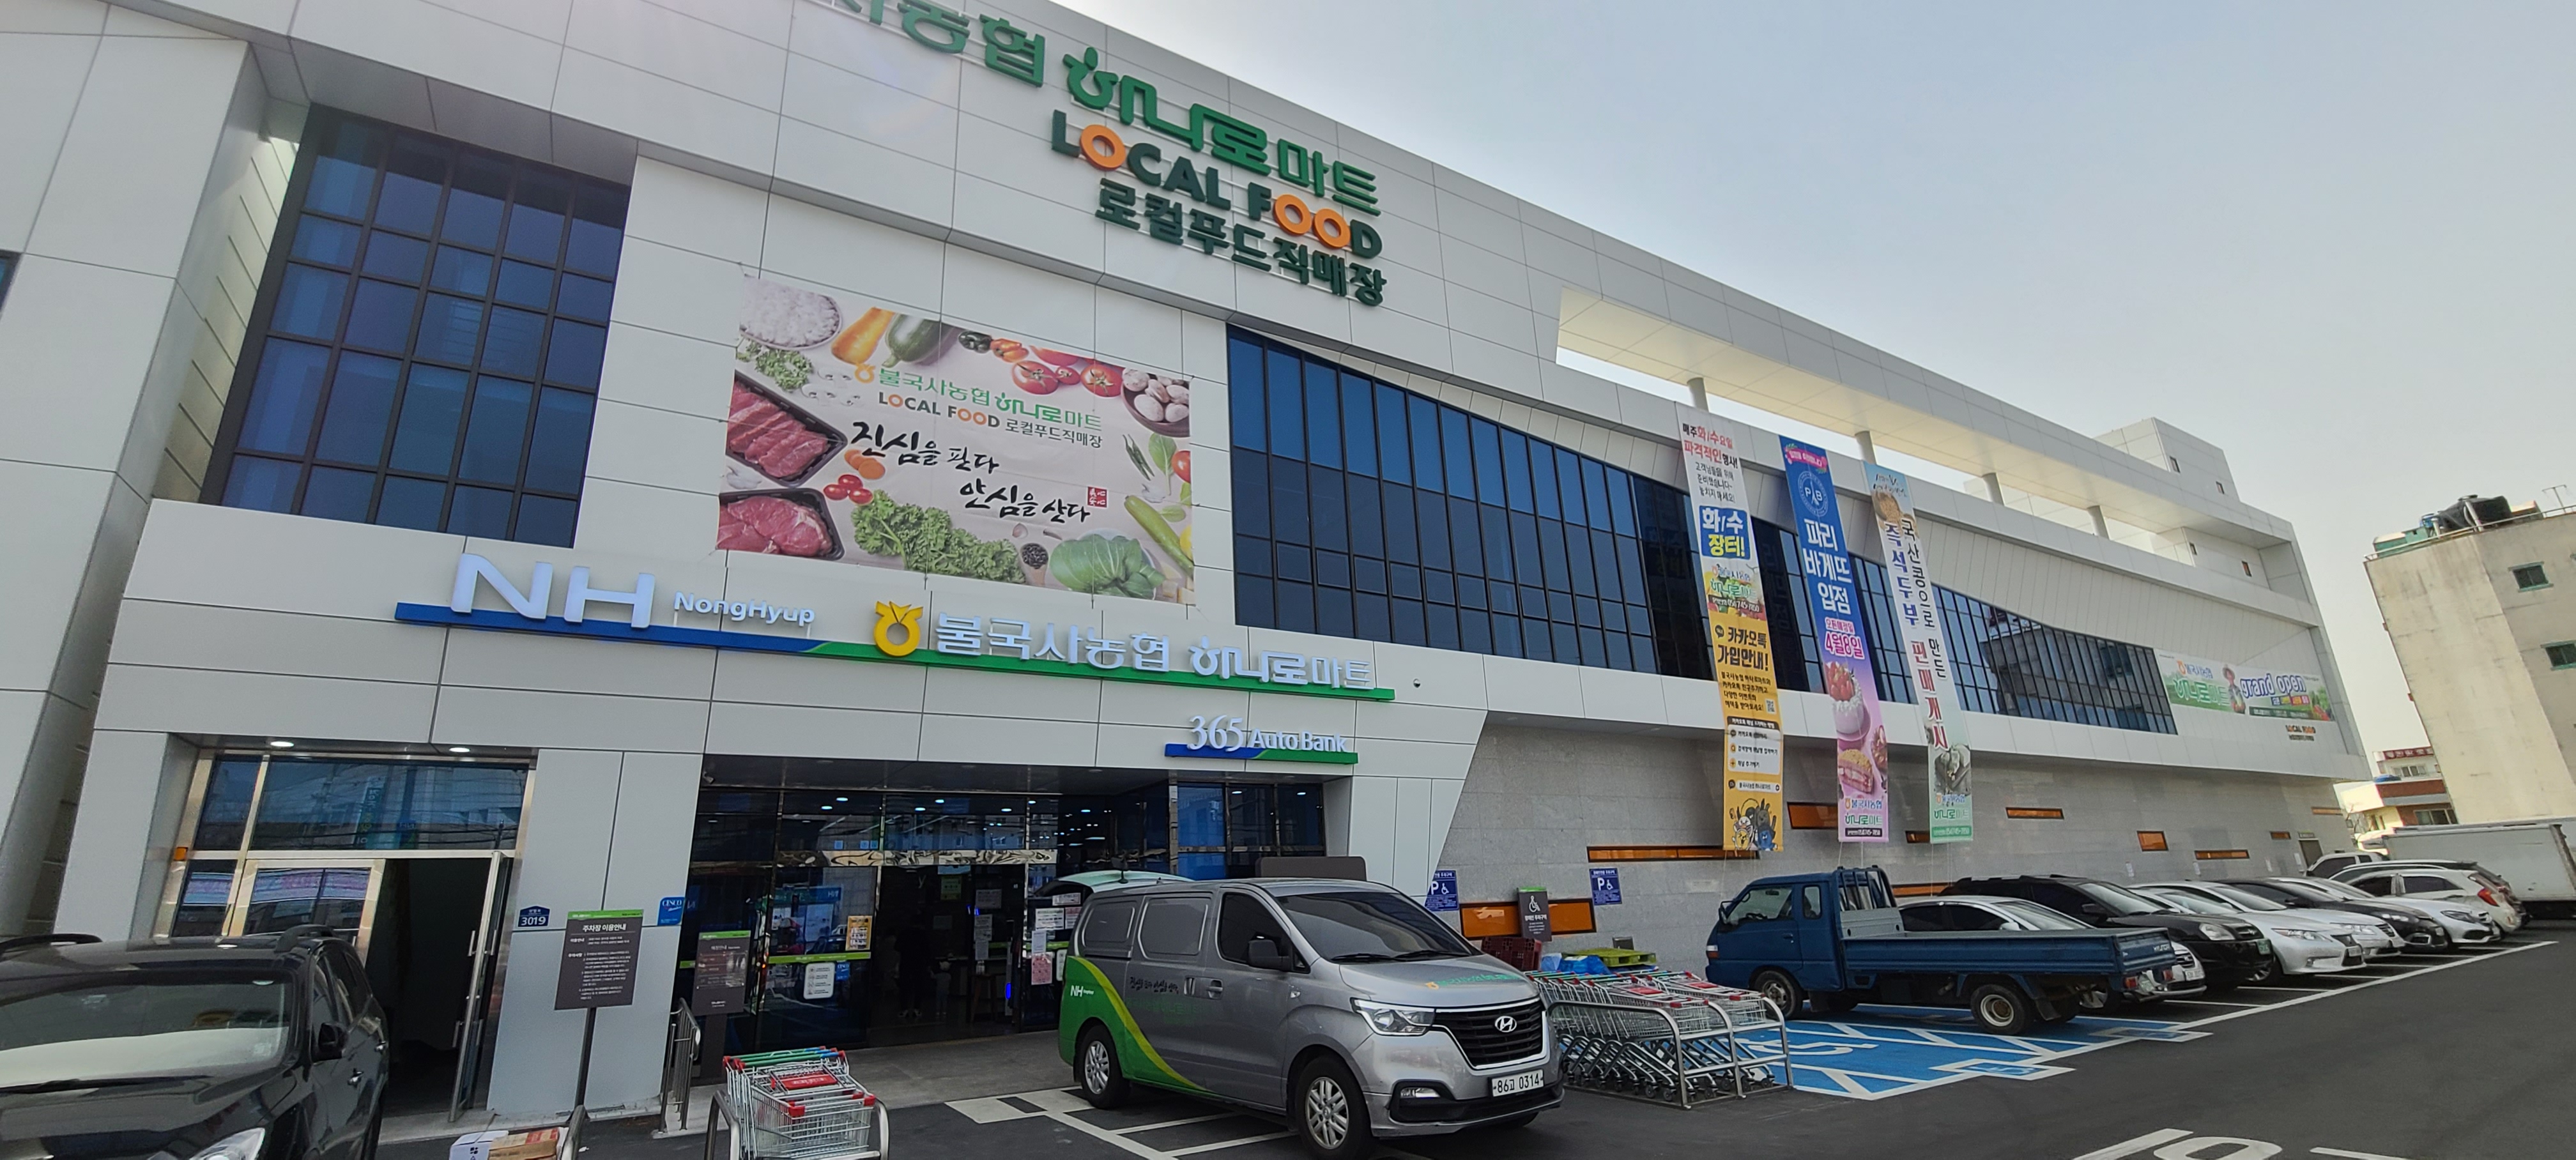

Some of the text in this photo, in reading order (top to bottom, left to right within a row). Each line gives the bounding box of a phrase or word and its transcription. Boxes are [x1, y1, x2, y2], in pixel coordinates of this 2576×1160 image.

[1062, 47, 1381, 218] 하나로마트
[1051, 109, 1383, 259] LOCAL FOOD
[1094, 178, 1387, 307] 로컬푸드직매장
[878, 368, 1103, 431] 불국사농협 하나로마트
[878, 392, 1000, 427] LOCAL FOOD
[850, 421, 1000, 474] 진심을 판다
[1006, 418, 1103, 448] 로컬푸드직매장
[960, 478, 1090, 523] 안심을 산다
[1702, 507, 1744, 535] 화/수
[1804, 518, 1838, 551] 파리
[1708, 534, 1745, 557] 장터!
[1802, 547, 1852, 583] 바게뜨
[450, 553, 816, 629] NH NongHyup
[1818, 582, 1851, 614] 입점
[935, 612, 1375, 691] 불국사농협 하나로마트
[1728, 627, 1767, 649] 카카오톡
[2240, 673, 2306, 698] grand open
[1188, 715, 1348, 752] 365 Auto Bank
[1431, 881, 1439, 895] P
[1597, 877, 1605, 891] P
[521, 916, 546, 926] 3019
[582, 924, 601, 932] 주차장
[1070, 985, 1084, 996] NH
[1498, 1073, 1540, 1093] 86고 0314
